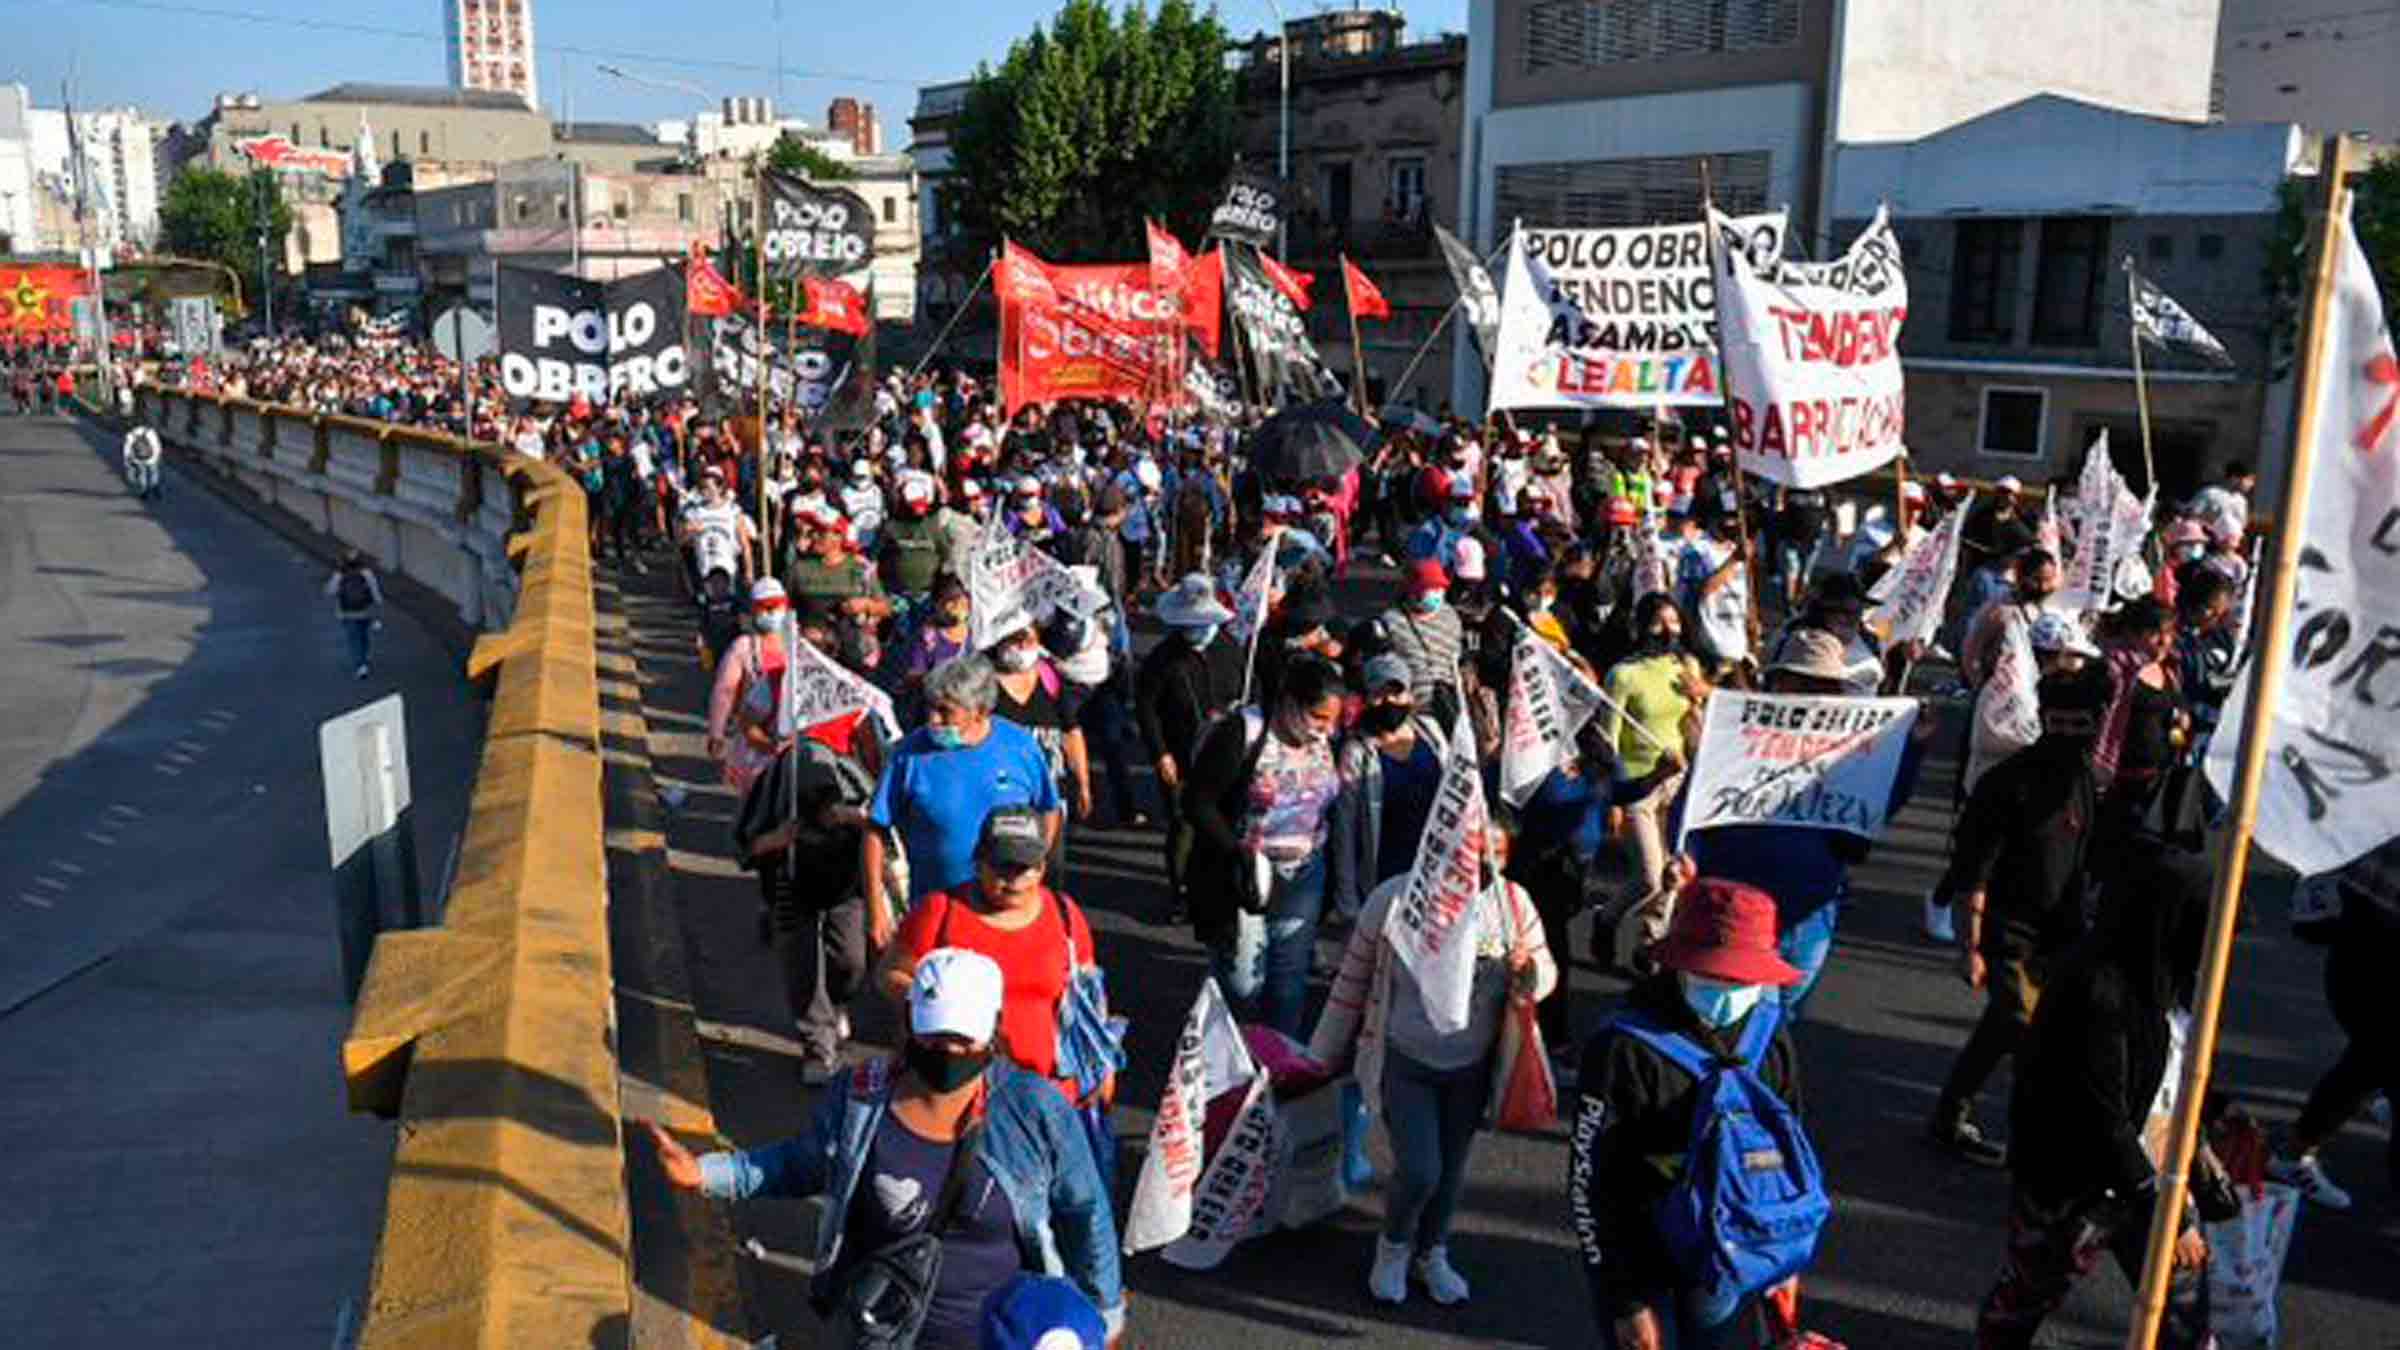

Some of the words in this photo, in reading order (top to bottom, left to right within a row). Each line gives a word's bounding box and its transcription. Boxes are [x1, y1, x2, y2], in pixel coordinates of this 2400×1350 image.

[774, 199, 848, 230] POLO
[1526, 234, 1616, 269] POLO
[533, 302, 656, 353] POLO
[502, 345, 689, 404] OBRERO
[1556, 355, 1726, 394] LEALTA
[1741, 700, 1807, 729] POLO
